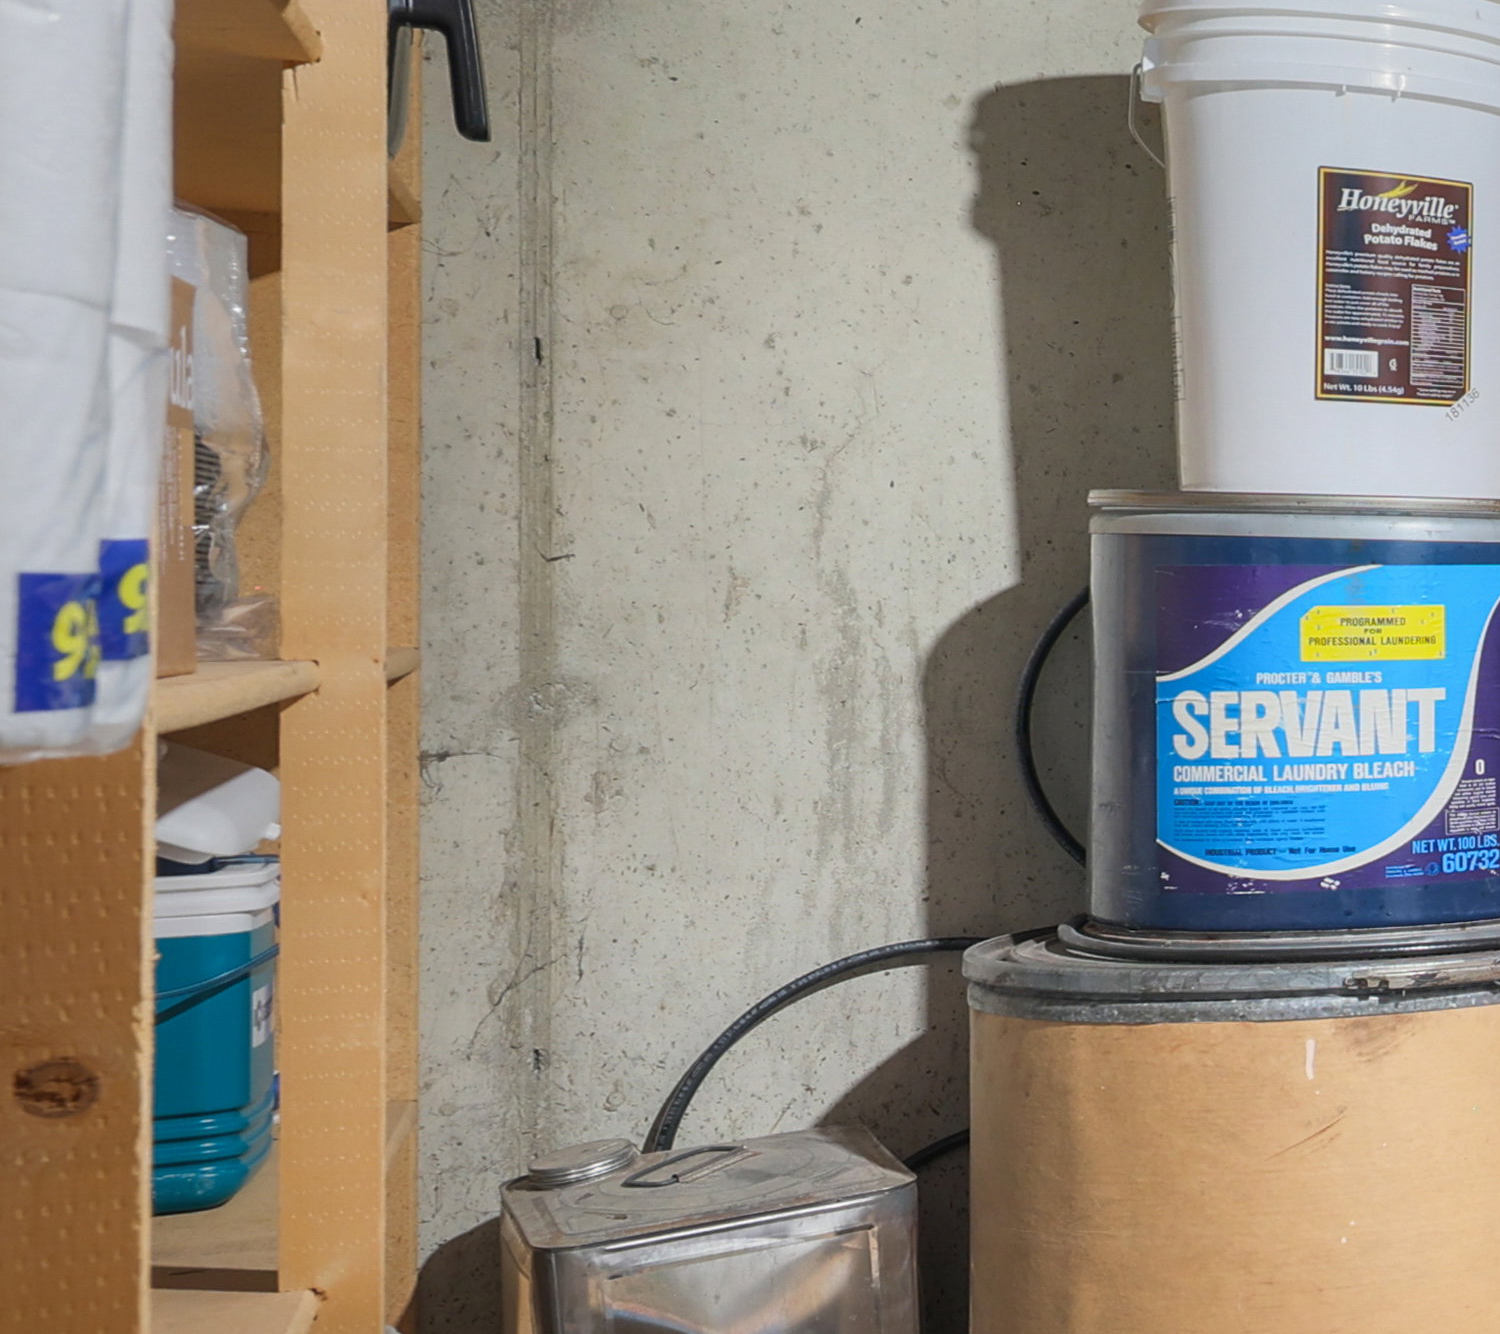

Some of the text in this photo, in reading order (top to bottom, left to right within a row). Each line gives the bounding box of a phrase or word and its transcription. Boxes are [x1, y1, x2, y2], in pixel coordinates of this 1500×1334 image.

[1336, 187, 1454, 219] Honeyville
[1372, 223, 1431, 238] Dehydrated
[1364, 235, 1438, 251] Potato Flakes
[1445, 388, 1480, 421] 181136
[1339, 617, 1407, 628] PROGRAMMED
[1364, 627, 1382, 635] FOR
[1308, 634, 1437, 647] PROFESSIONAL LAUNDERING
[1256, 672, 1382, 685] PROCTER & GAMBLE'S
[1172, 687, 1446, 761] SERVANT
[1173, 761, 1415, 783] COMMERCIAL LAUNDRY BLEACH
[1412, 834, 1500, 854] NET WT. 100 LBS.
[1442, 850, 1500, 874] 60732
